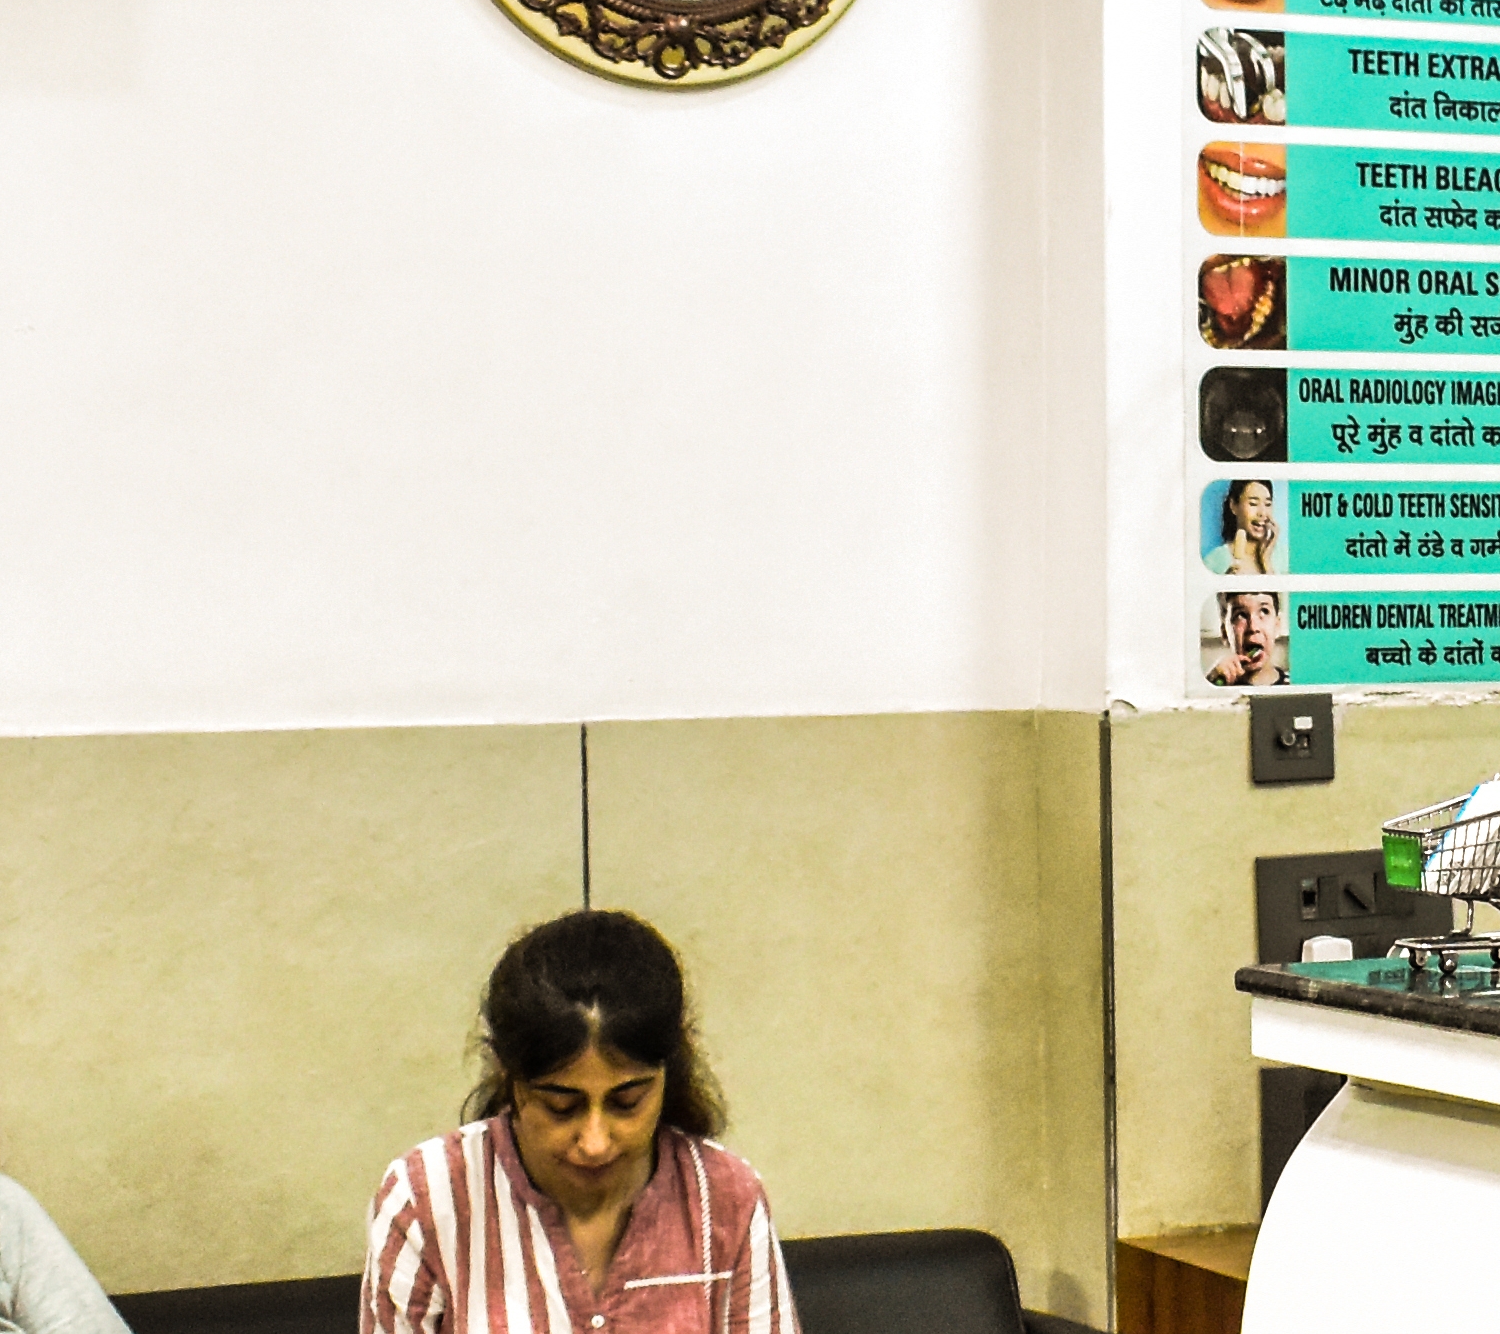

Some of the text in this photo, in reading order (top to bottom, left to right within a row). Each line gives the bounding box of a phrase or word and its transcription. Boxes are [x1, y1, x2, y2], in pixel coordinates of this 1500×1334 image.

[1348, 49, 1419, 77] TEETH
[1389, 90, 1427, 119] दांत
[1356, 162, 1427, 189] TEETH
[1379, 198, 1417, 228] दांत
[1424, 199, 1477, 230] सफेद
[1330, 267, 1410, 294] MINOR
[1418, 269, 1478, 296] ORAL
[1394, 308, 1428, 345] मुंह
[1435, 307, 1463, 337] की
[1299, 377, 1344, 403] ORAL
[1350, 378, 1446, 405] RADIOLOGY
[1331, 415, 1360, 454] पूरे
[1367, 418, 1401, 455] मुंह
[1408, 425, 1423, 446] व
[1430, 416, 1475, 447] दांतो
[1302, 492, 1333, 518] HOT
[1338, 493, 1348, 518] &
[1353, 493, 1393, 518] COLD
[1398, 493, 1445, 518] TEETH
[1298, 604, 1371, 629] CHILDREN
[1377, 604, 1434, 629] DENTAL
